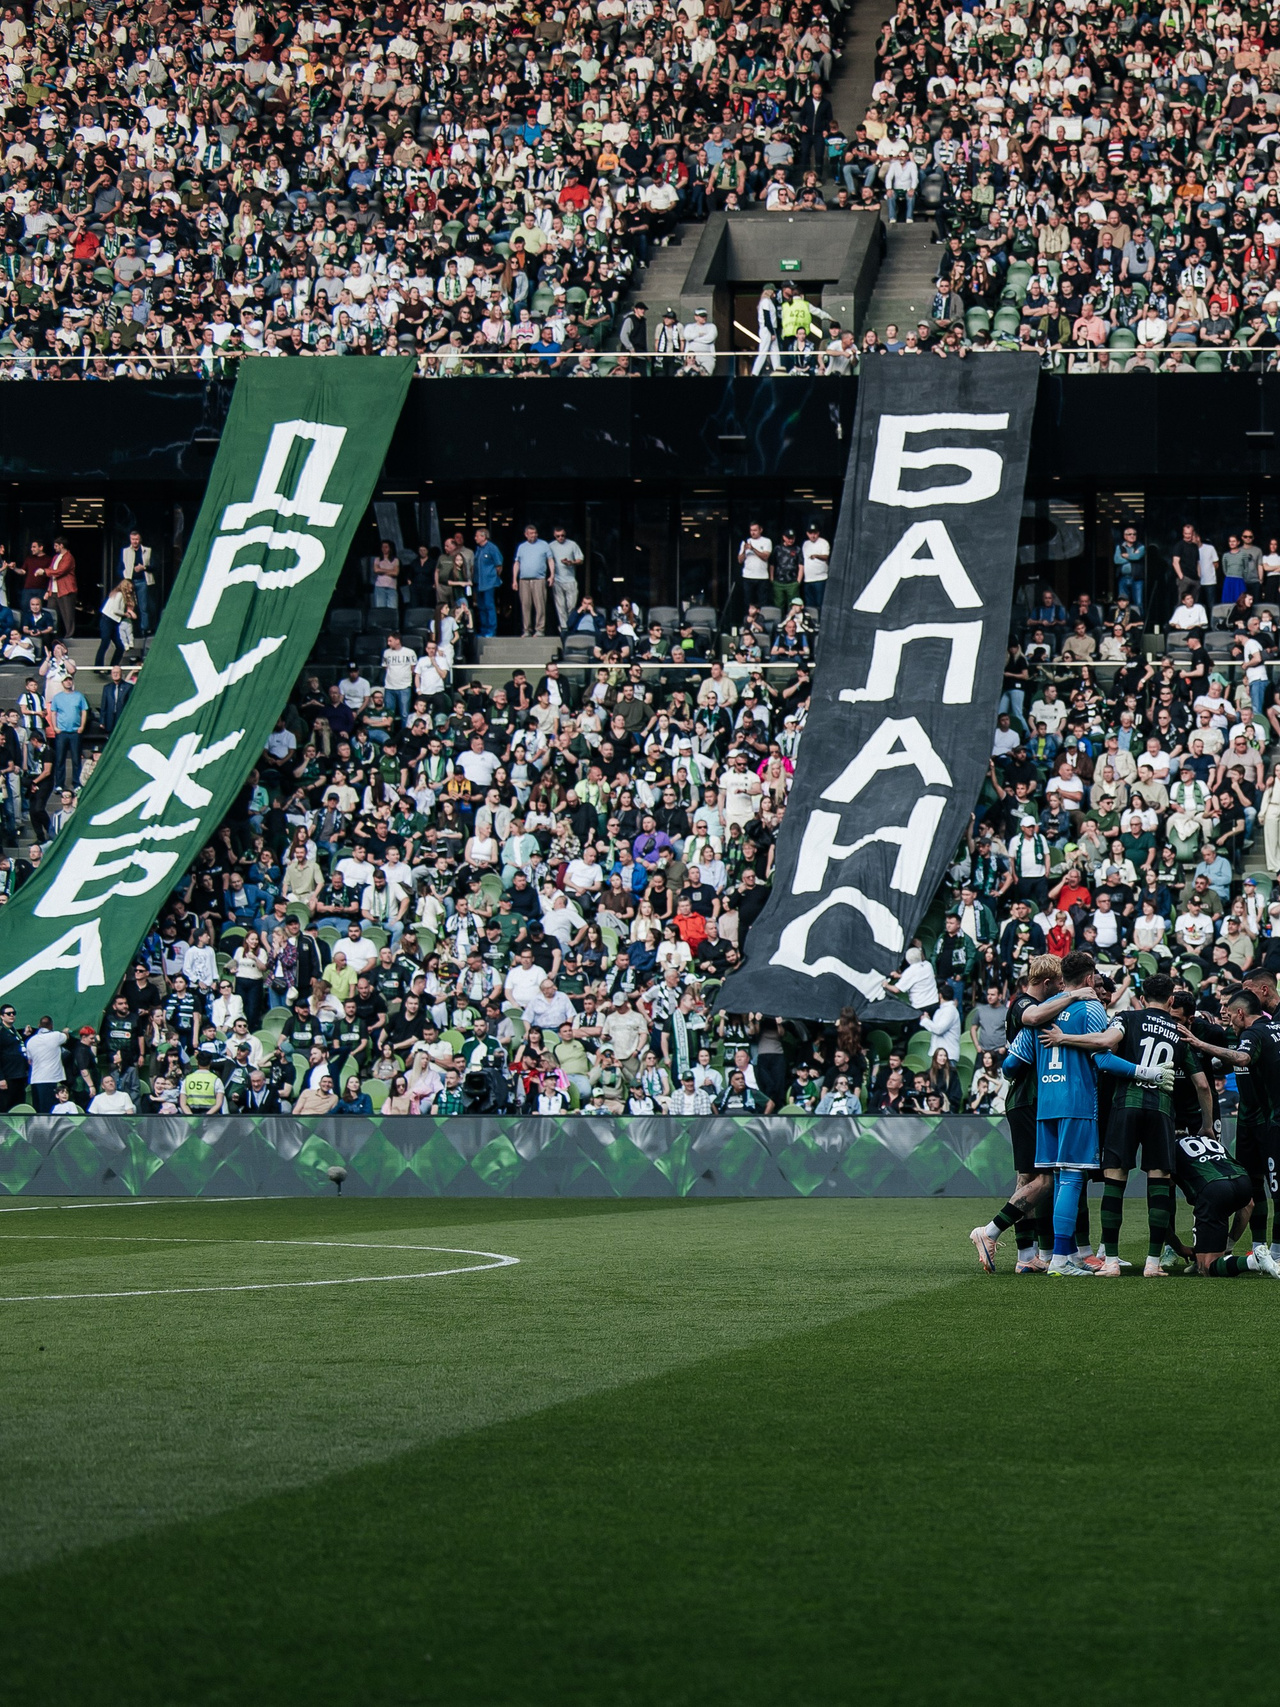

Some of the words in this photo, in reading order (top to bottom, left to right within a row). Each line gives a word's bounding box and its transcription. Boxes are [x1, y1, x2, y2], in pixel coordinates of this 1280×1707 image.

[0, 418, 348, 998] ДРУЖБА
[768, 411, 1010, 1003] БАЛАНС
[1141, 1022, 1181, 1044] СПЕРЦЯН
[1139, 1035, 1175, 1068] 10
[188, 1080, 211, 1091] 057
[1179, 1135, 1226, 1158] 66
